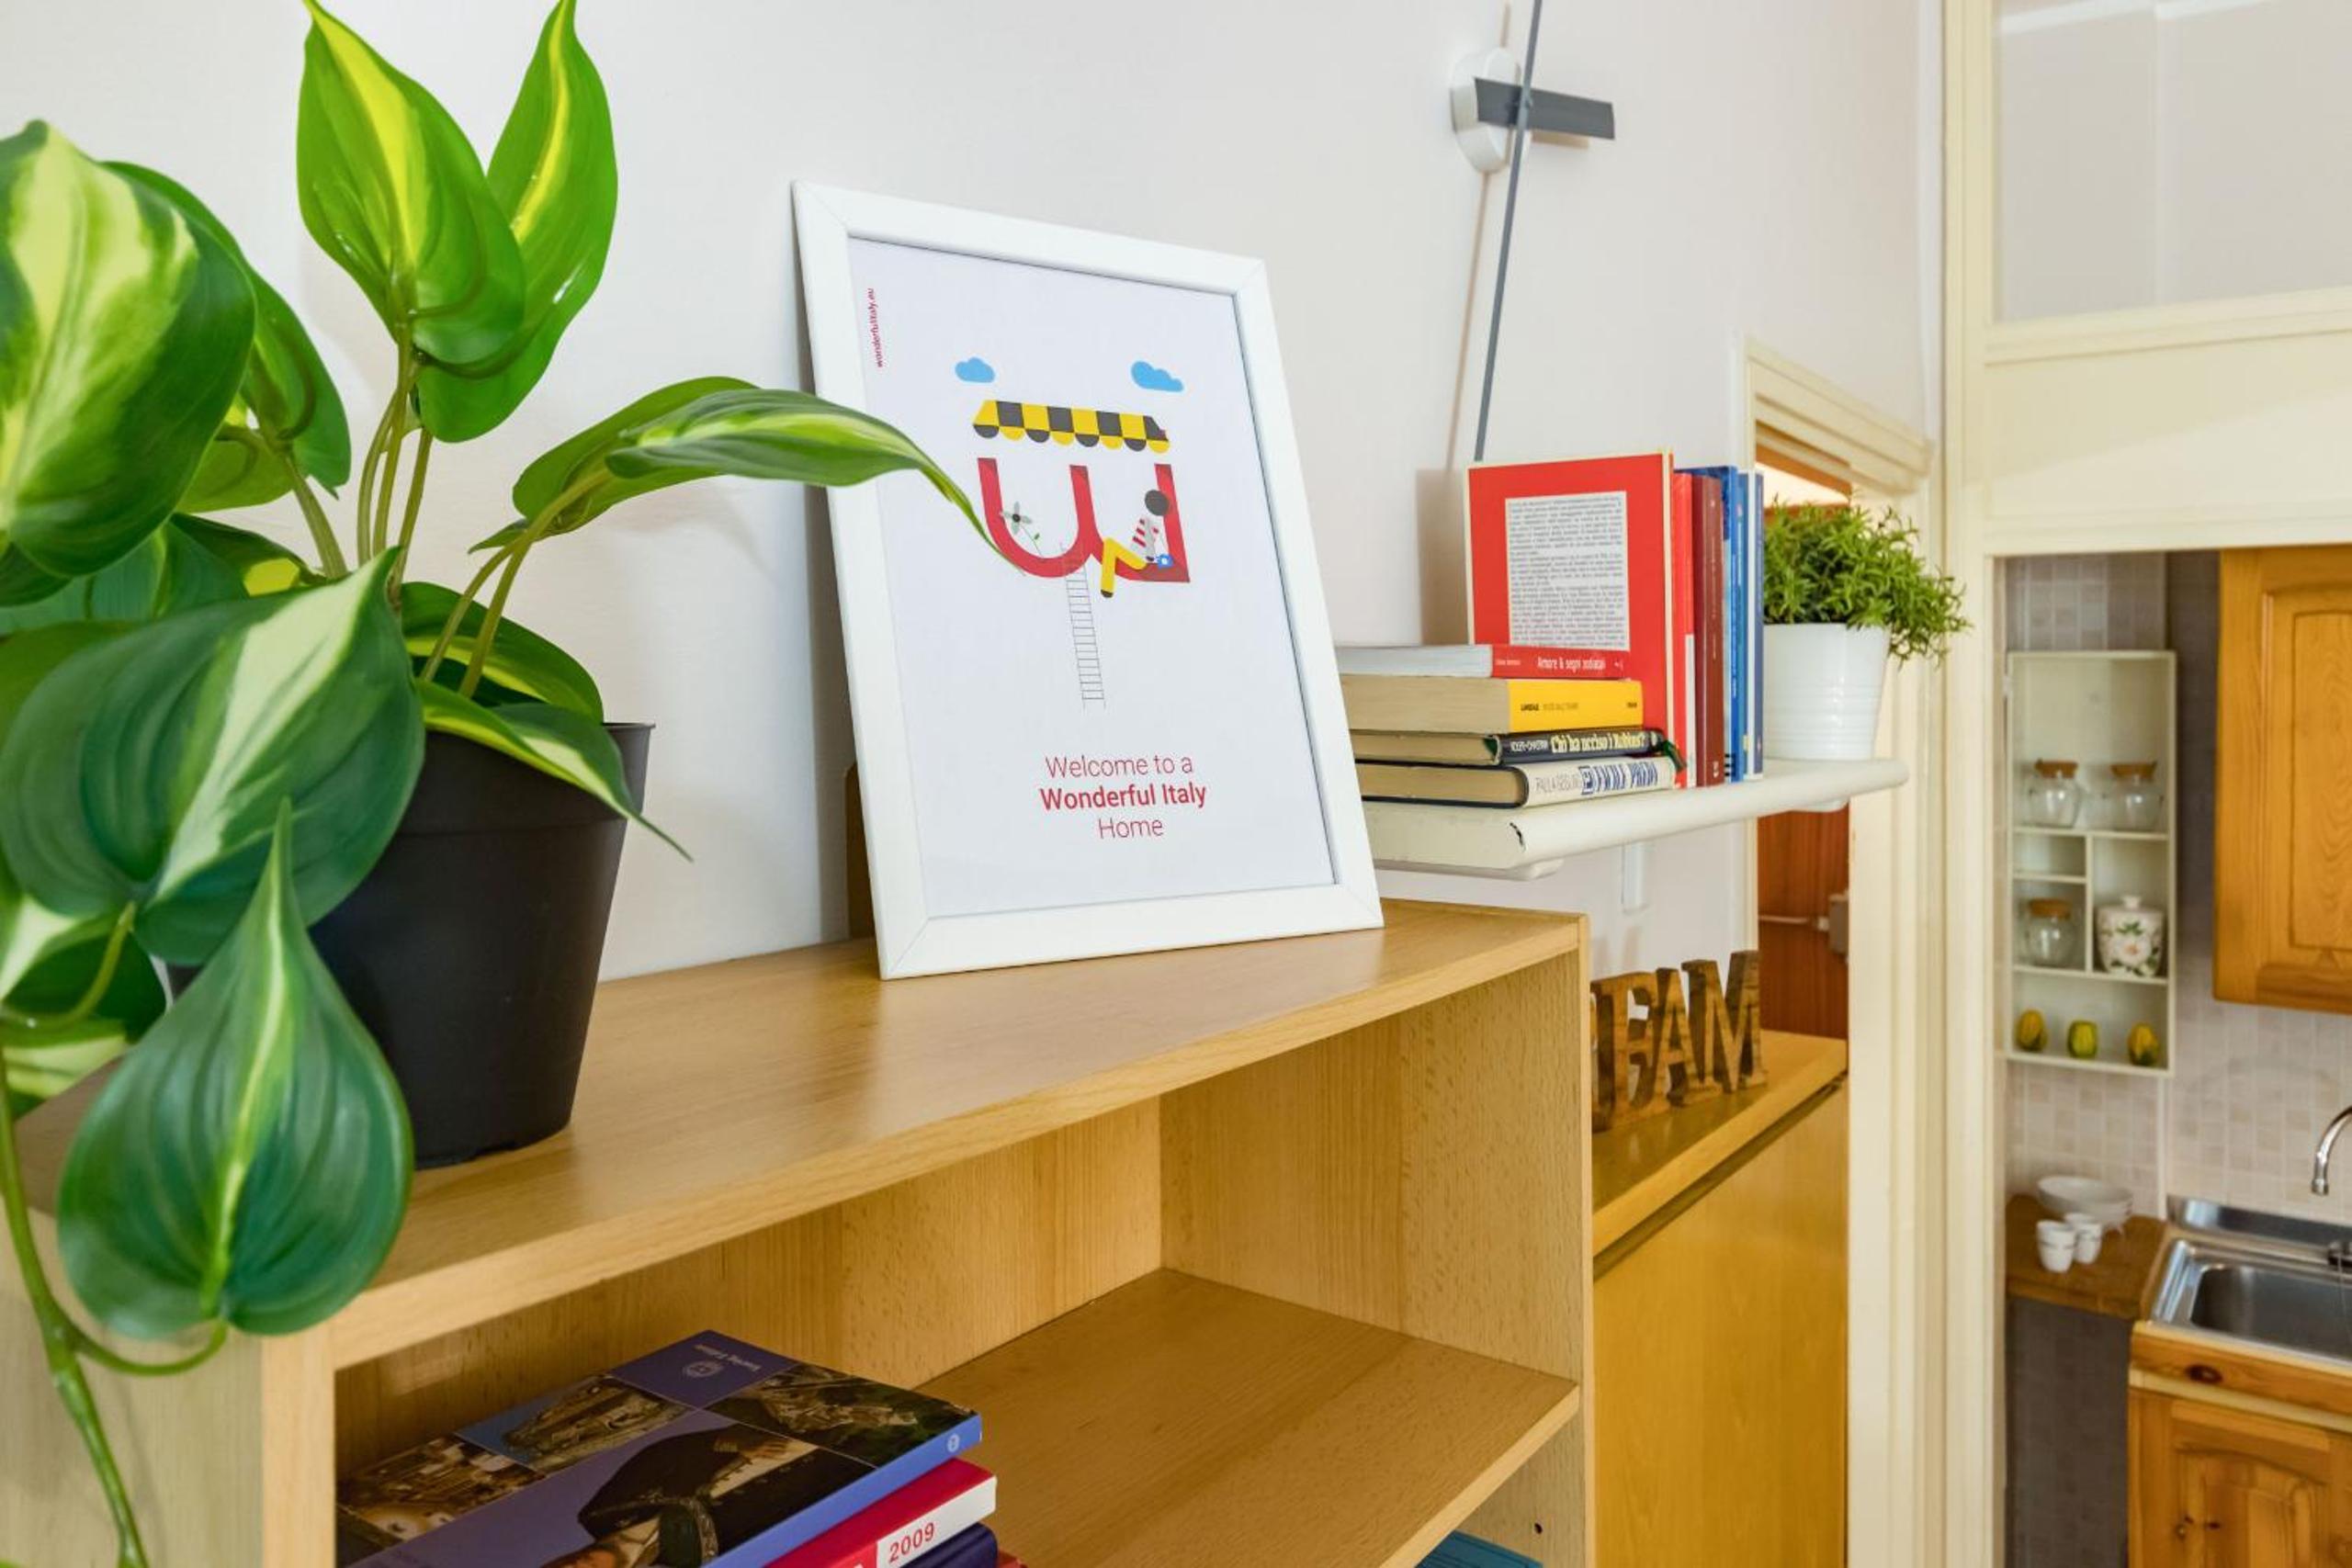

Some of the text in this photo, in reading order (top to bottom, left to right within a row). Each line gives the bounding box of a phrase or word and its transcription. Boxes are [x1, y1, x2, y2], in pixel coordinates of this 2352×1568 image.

[1045, 754, 1193, 779] Welcome to a
[1039, 781, 1206, 811] Wonderful Italy
[1098, 817, 1165, 840] Home
[1590, 950, 1769, 1134] EAM
[888, 1521, 936, 1563] 2009
